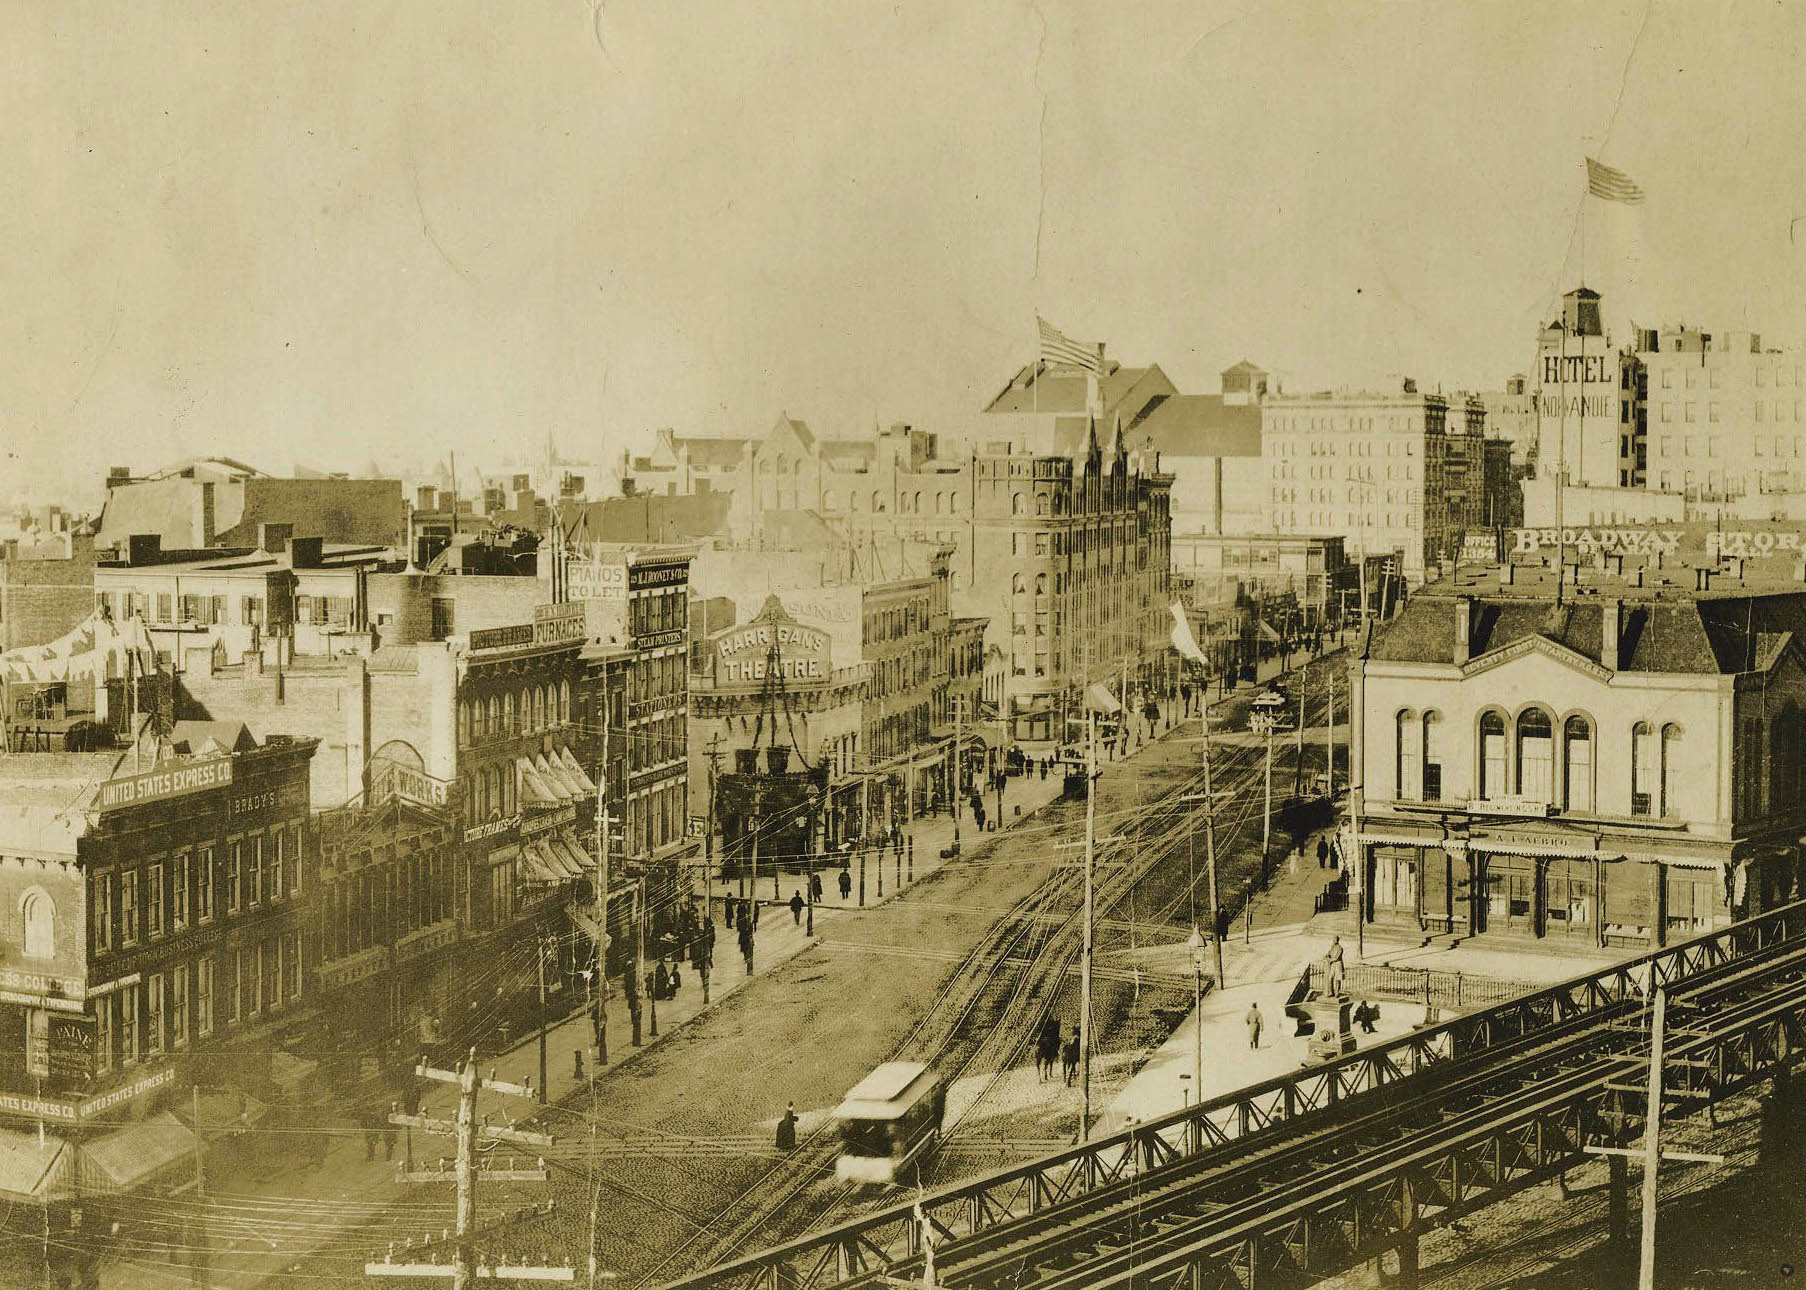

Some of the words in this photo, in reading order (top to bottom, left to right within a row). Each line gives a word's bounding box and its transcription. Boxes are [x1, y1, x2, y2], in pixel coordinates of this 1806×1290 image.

[1544, 355, 1612, 383] HOTEL
[1543, 396, 1614, 418] NORANDIE
[1464, 535, 1497, 547] OFFICE
[1514, 529, 1687, 553] BROADWAY
[1706, 531, 1806, 552] STOR
[570, 586, 589, 598] TO
[592, 586, 623, 598] LET
[536, 617, 585, 644] FURNACES
[637, 633, 655, 648] STEAM
[718, 626, 824, 659] HARRGAN'S
[636, 694, 682, 716] STATIONERS
[103, 781, 136, 807] UNITED
[136, 774, 171, 799] STATES
[173, 764, 216, 792] EXPRESS
[402, 769, 443, 806] WORKS
[235, 791, 276, 814] BRADY'S
[80, 1098, 107, 1118] UNITED
[107, 1087, 133, 1107] STATES
[135, 1072, 164, 1095] EXPRESS
[21, 1098, 61, 1117] EXPRESS
